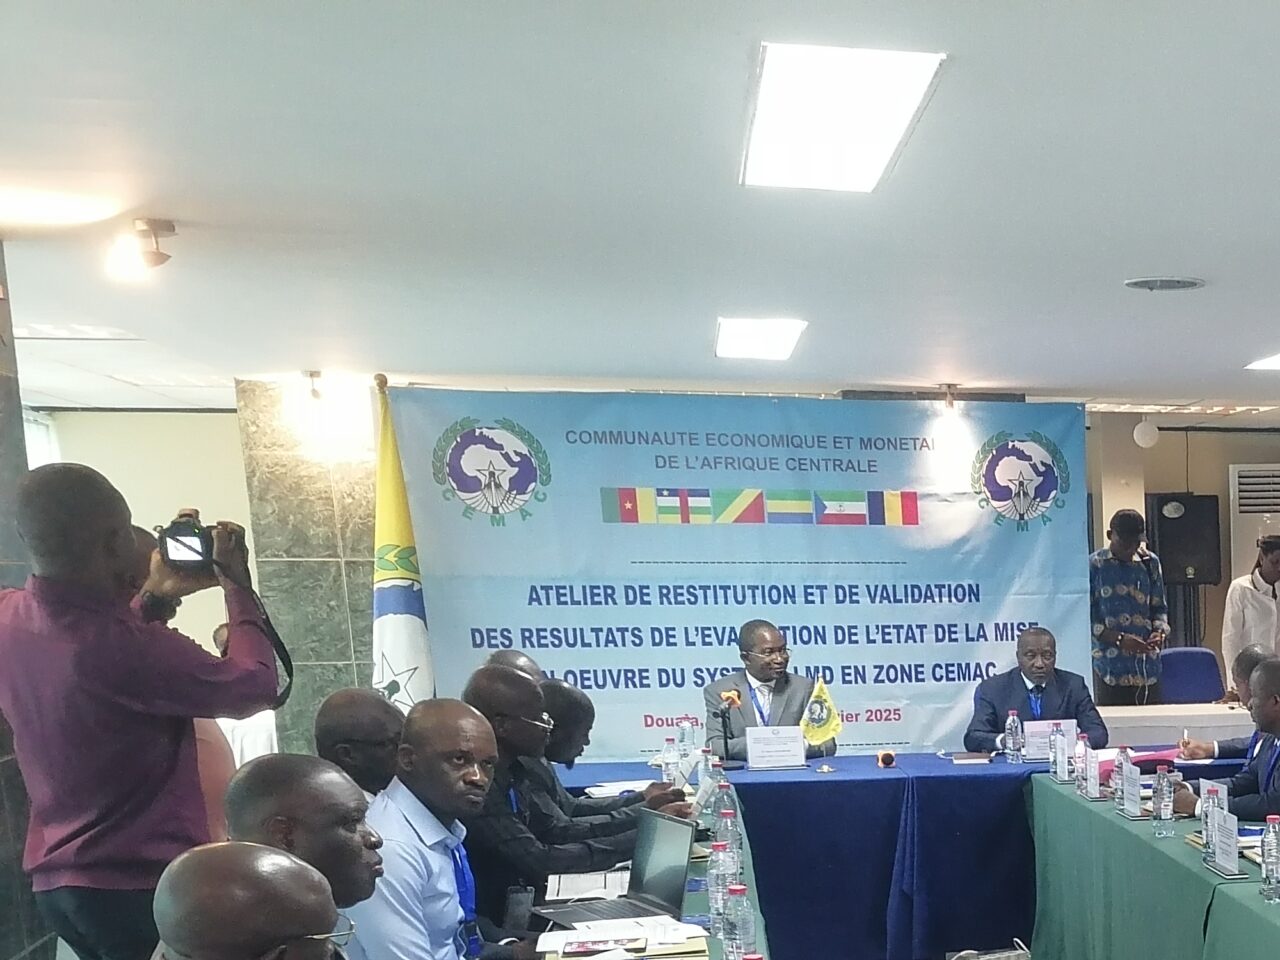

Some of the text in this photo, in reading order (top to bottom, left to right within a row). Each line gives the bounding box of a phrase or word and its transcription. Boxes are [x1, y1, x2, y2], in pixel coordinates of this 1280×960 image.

[565, 430, 936, 452] COMMUNAUTE ECONOMIQUE ET MONETAI
[654, 454, 878, 473] DE L'AFRIQUE CENTRALE
[443, 490, 548, 527] CEMAC
[978, 497, 1066, 532] CEMAC
[527, 583, 981, 606] ATELIER DE RESTITUTION ET DE VALIDATION
[470, 627, 513, 649] DES
[520, 626, 644, 649] RESULTATS
[650, 626, 678, 647] DE
[833, 624, 860, 645] DE
[865, 623, 928, 645] L'ETAT
[934, 623, 959, 643] DE
[964, 622, 989, 643] LA
[563, 668, 651, 690] OEUVRE
[657, 667, 686, 689] DU
[840, 664, 867, 685] EN
[872, 663, 926, 684] ZONE
[865, 708, 902, 722] 2025
